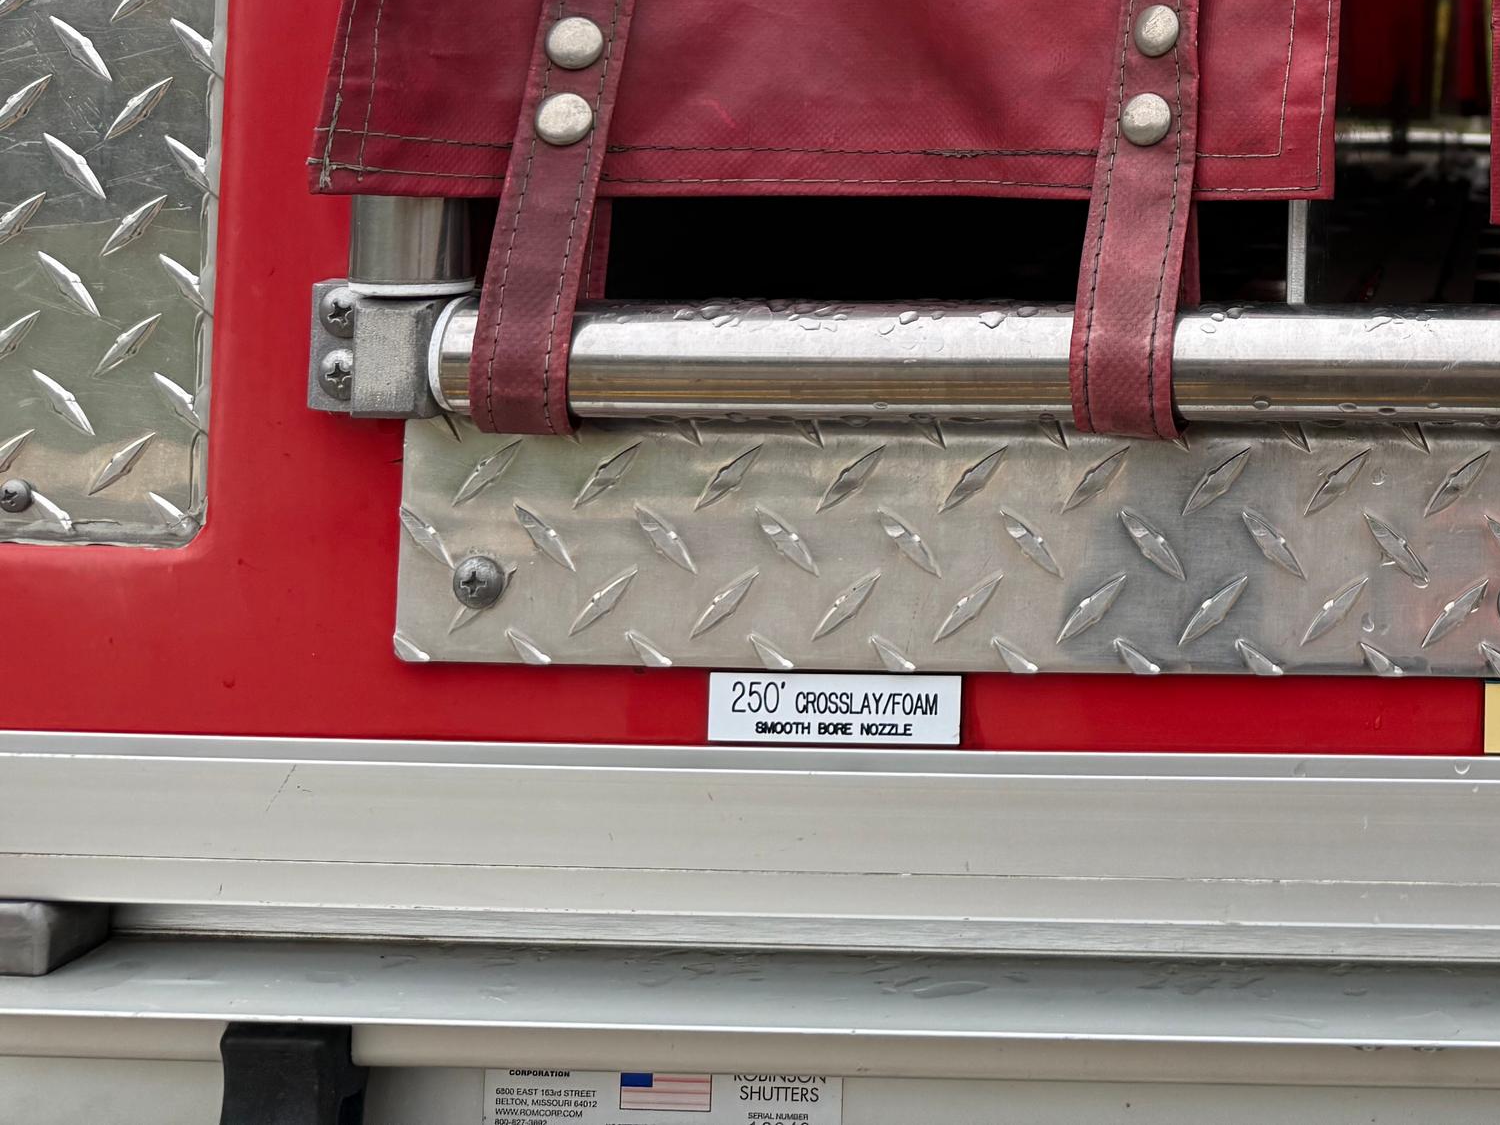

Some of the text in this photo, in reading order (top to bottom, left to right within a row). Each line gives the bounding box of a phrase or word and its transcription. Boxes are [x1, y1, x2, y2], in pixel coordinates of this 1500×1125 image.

[732, 681, 938, 715] 250' CROSSLAY/FOAM
[755, 722, 912, 737] SMOOTH BORE NOZZLE
[509, 1069, 571, 1077] CORPORATION
[516, 1088, 538, 1096] EAST
[563, 1089, 597, 1098] STREET
[739, 1085, 820, 1103] SHUTTERS
[531, 1099, 572, 1108] MISSOURI
[573, 1100, 598, 1108] 64012
[747, 1112, 809, 1121] SERIAL NUMBER
